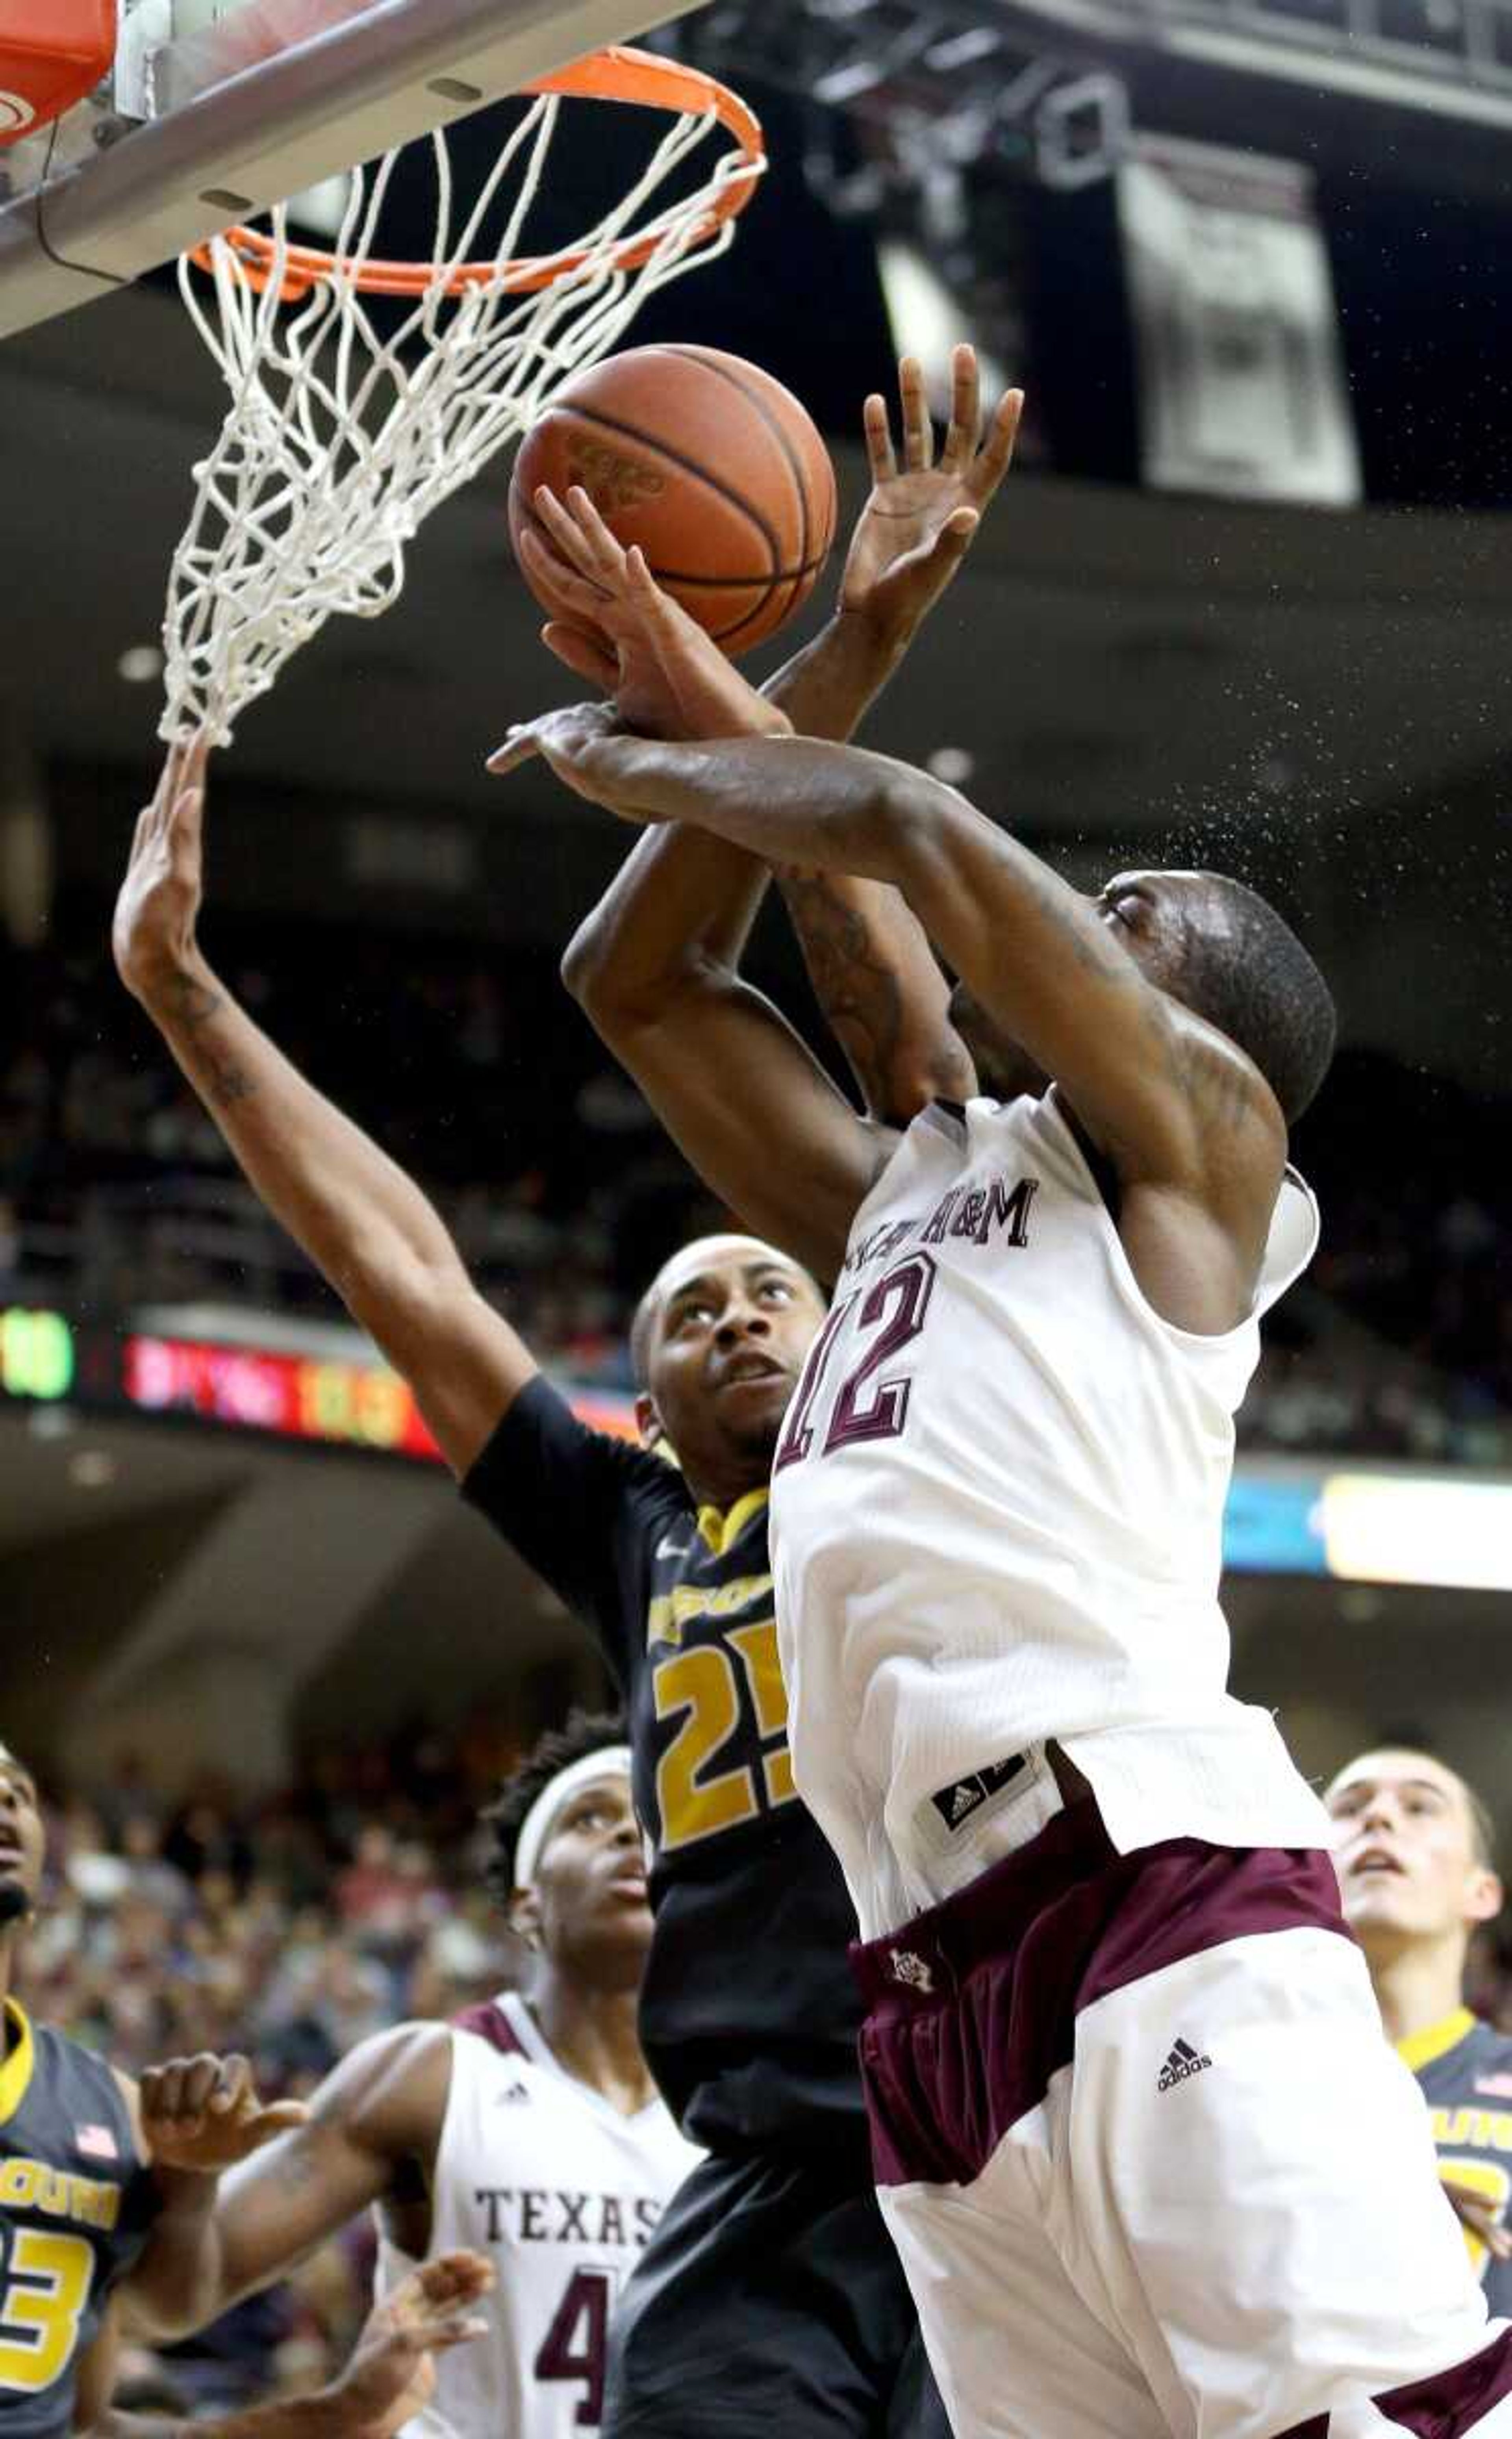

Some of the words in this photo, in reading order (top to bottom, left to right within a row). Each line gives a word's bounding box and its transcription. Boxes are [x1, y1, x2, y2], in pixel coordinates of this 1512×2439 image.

[775, 1250, 937, 1474] 12
[1158, 2054, 1212, 2091] adidas
[475, 2189, 662, 2246] TEXAS
[0, 2226, 96, 2393] 3
[535, 2264, 618, 2426] 4
